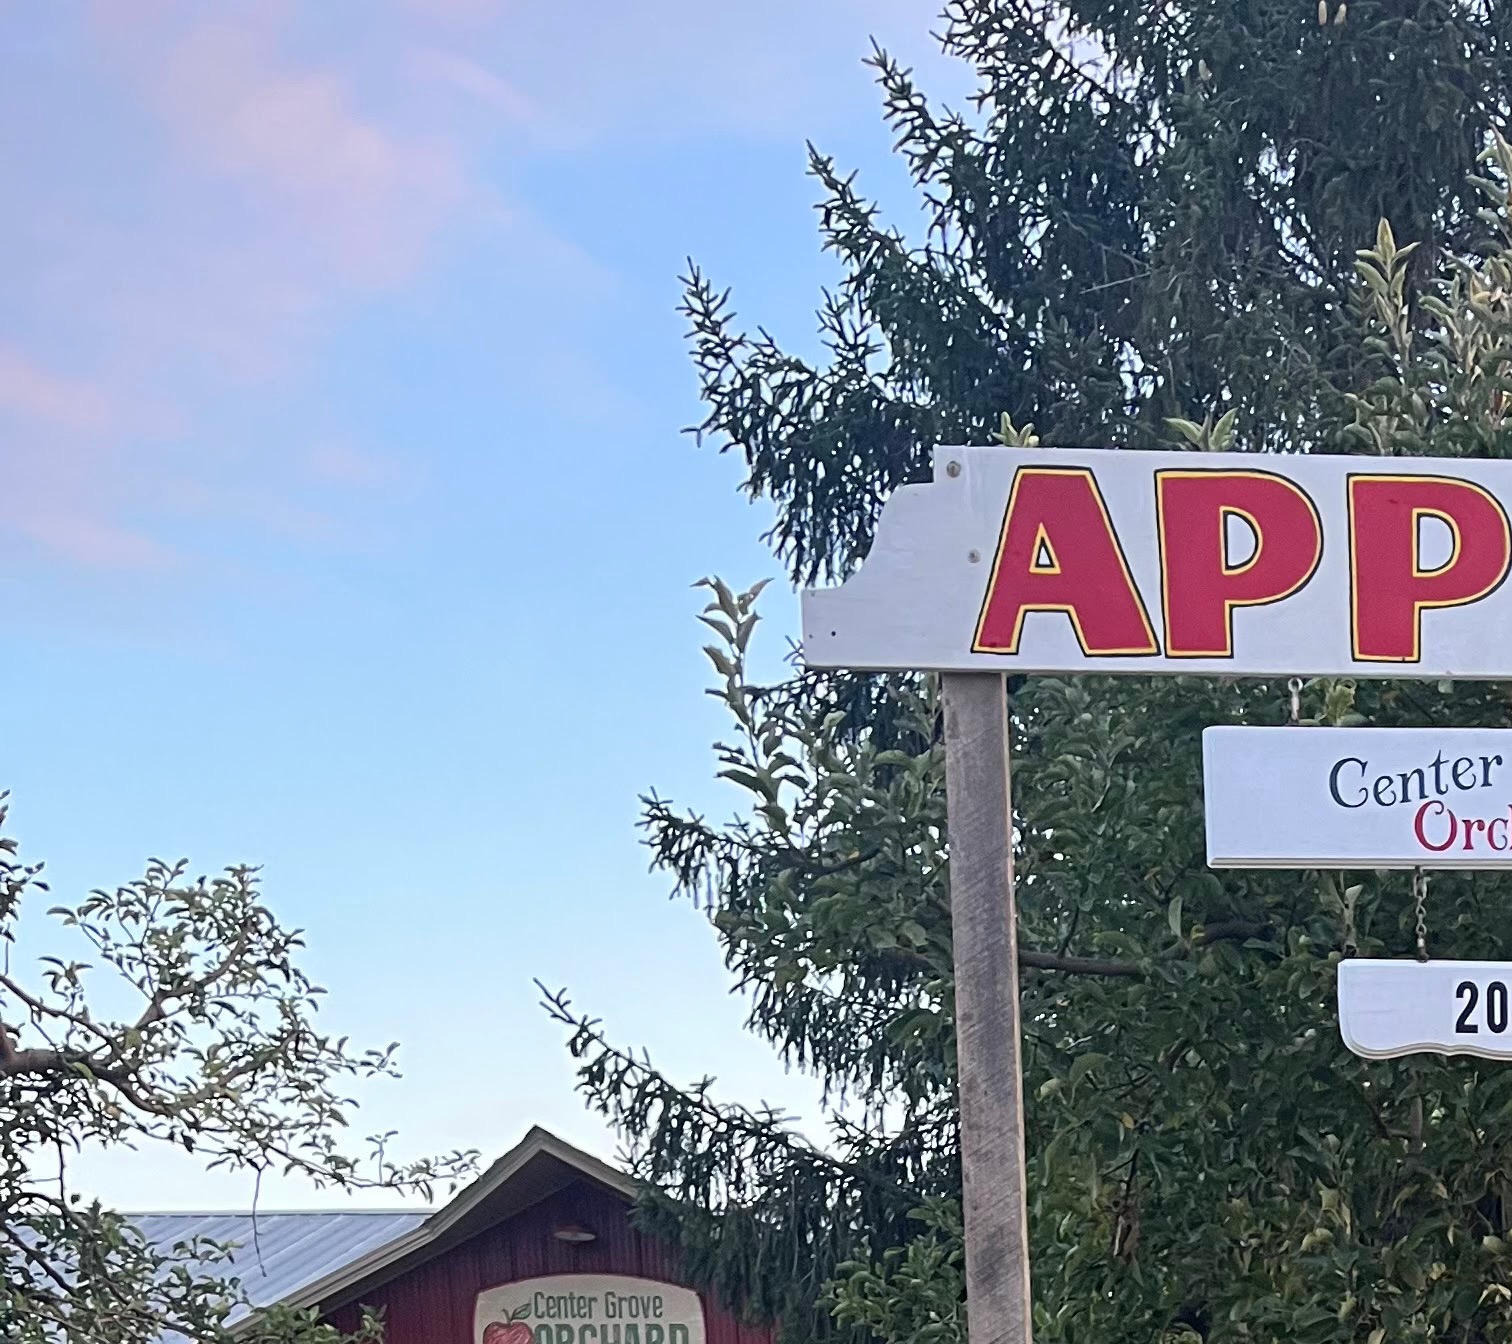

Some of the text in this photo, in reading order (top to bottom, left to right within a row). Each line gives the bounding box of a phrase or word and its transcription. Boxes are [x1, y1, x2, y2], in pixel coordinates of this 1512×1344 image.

[1328, 750, 1503, 808] Center
[533, 1291, 663, 1319] Center Grove
